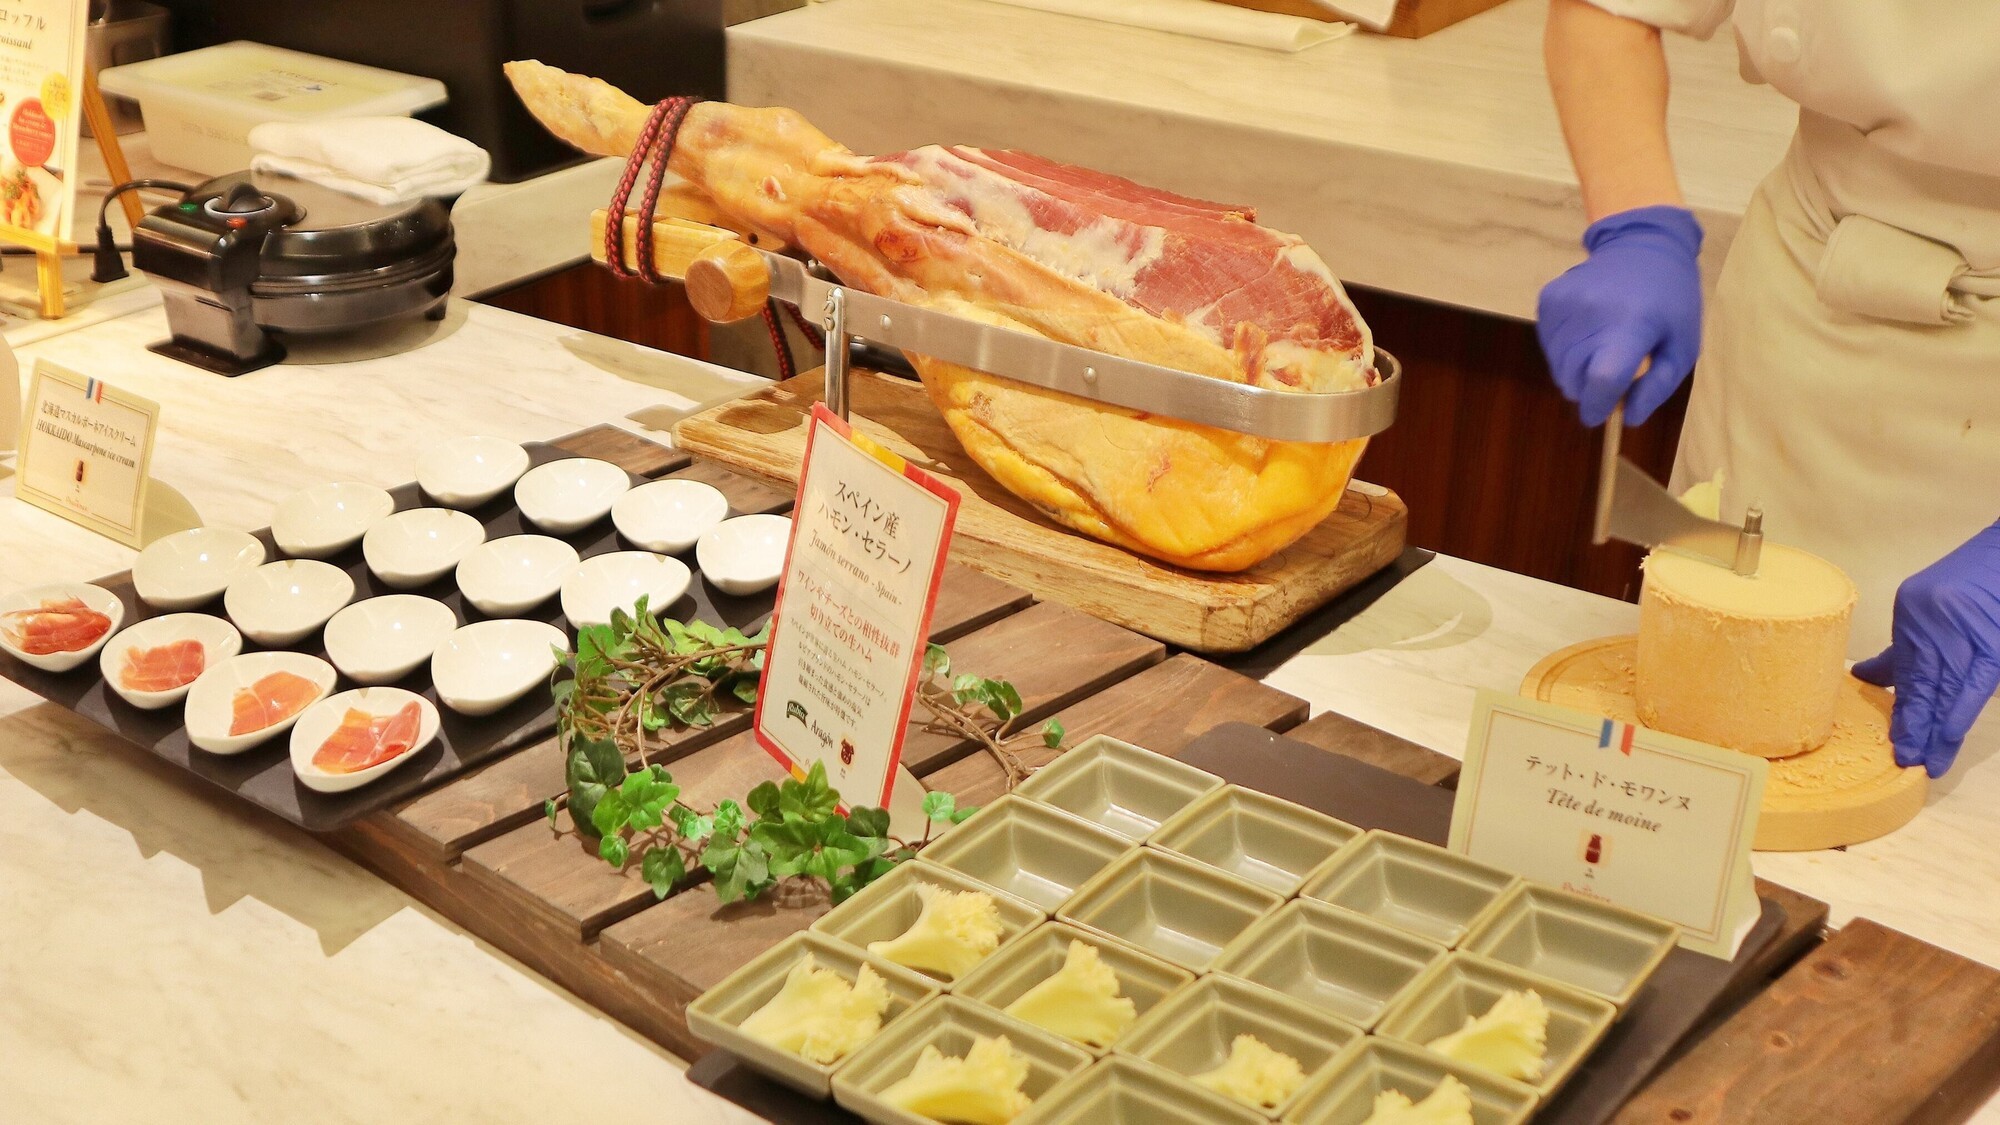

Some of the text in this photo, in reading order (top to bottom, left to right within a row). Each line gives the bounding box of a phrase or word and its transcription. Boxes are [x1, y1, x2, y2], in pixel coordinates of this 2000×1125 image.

[36, 419, 135, 469] HOKKAIDO Mascarpone ice cream
[818, 503, 912, 574] ハモン・セラーノ
[835, 480, 900, 539] スペイン産
[809, 529, 836, 560] Jamón
[837, 552, 870, 584] serrano
[798, 569, 900, 659] ワインやチーズとの相性抜群
[810, 603, 872, 663] 切り立ての生ハム
[1526, 754, 1691, 811] テット・ド・モワンヌ
[1547, 787, 1662, 833] Tête de moine
